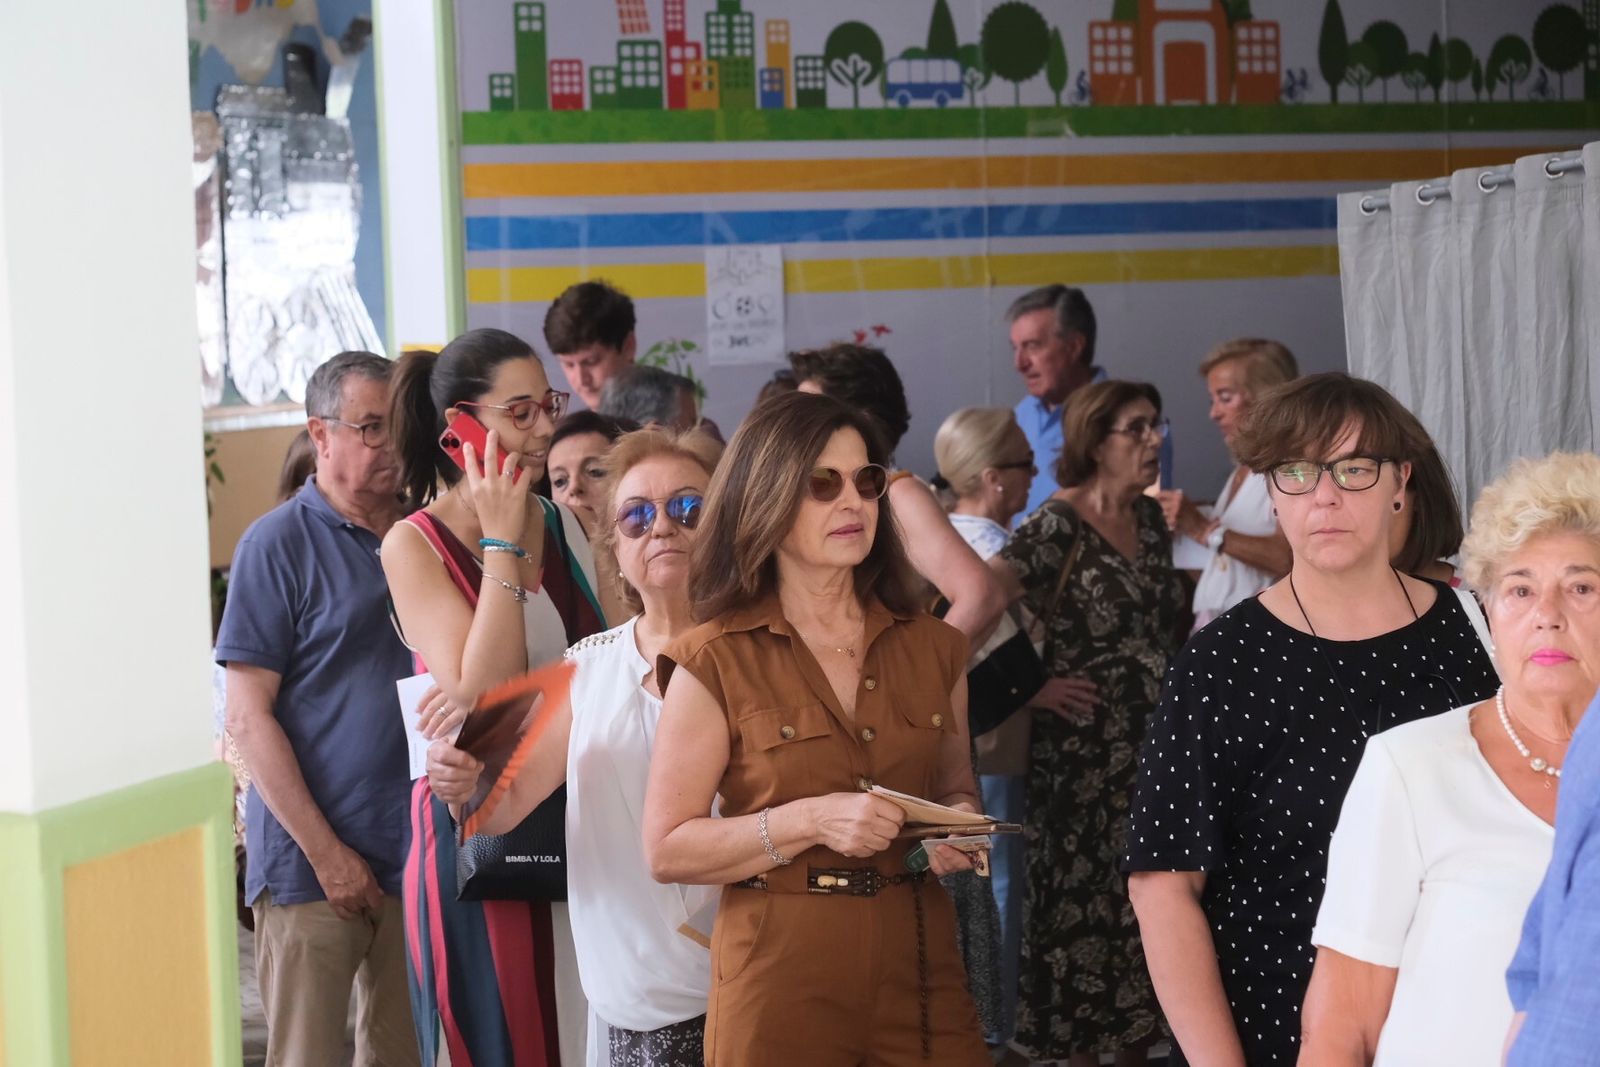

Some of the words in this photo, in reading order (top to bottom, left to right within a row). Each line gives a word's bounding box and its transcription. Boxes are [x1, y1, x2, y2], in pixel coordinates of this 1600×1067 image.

[505, 855, 532, 863] BIMBA
[532, 855, 539, 863] Y
[540, 855, 561, 863] LOLA
